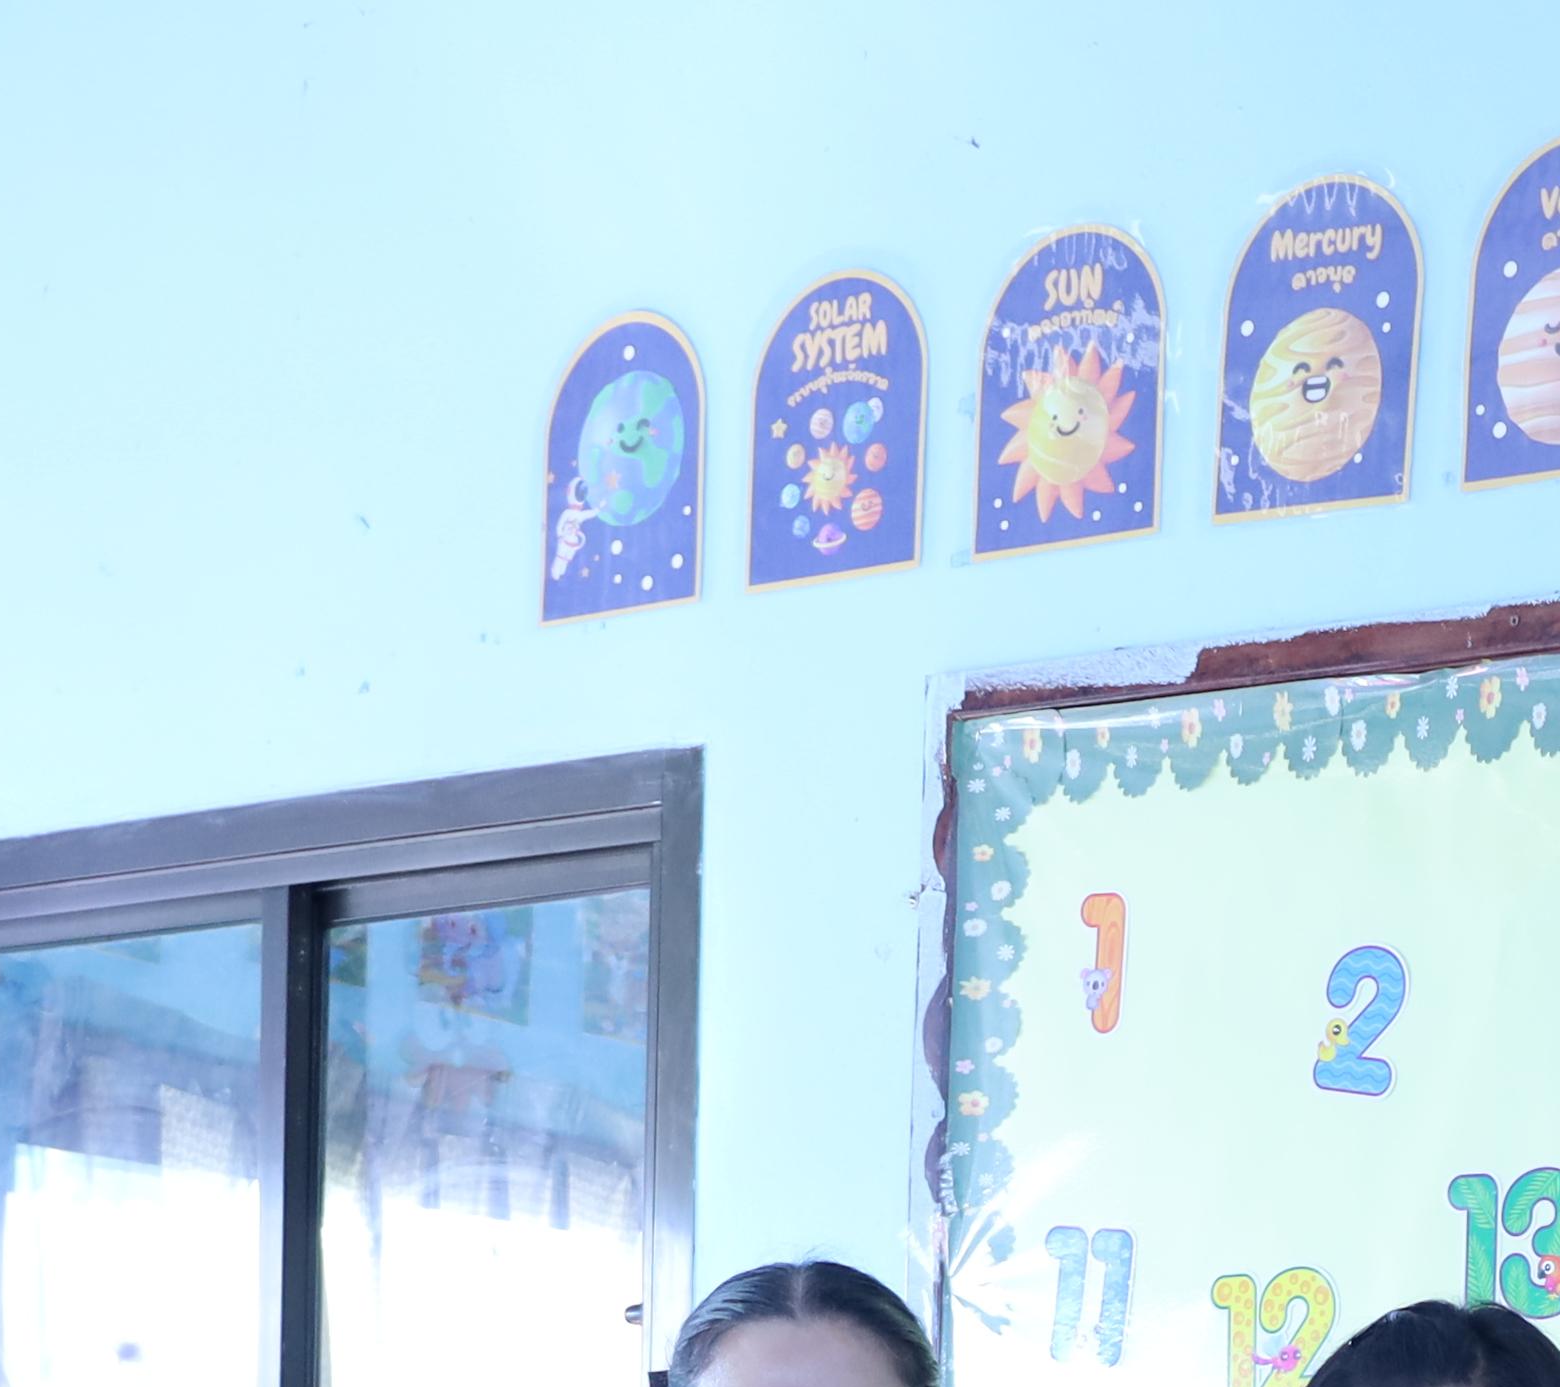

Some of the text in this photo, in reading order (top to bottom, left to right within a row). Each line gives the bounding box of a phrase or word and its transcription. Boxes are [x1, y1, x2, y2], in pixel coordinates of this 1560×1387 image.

[1270, 223, 1382, 262] Mercury
[1044, 262, 1104, 312] SUN
[1290, 264, 1356, 293] ดาวพุธ
[809, 292, 872, 330] SOLAR
[792, 320, 887, 372] SYSTEM
[1080, 893, 1127, 1033] 1
[1313, 945, 1407, 1096] 2
[1045, 1225, 1135, 1367] 11
